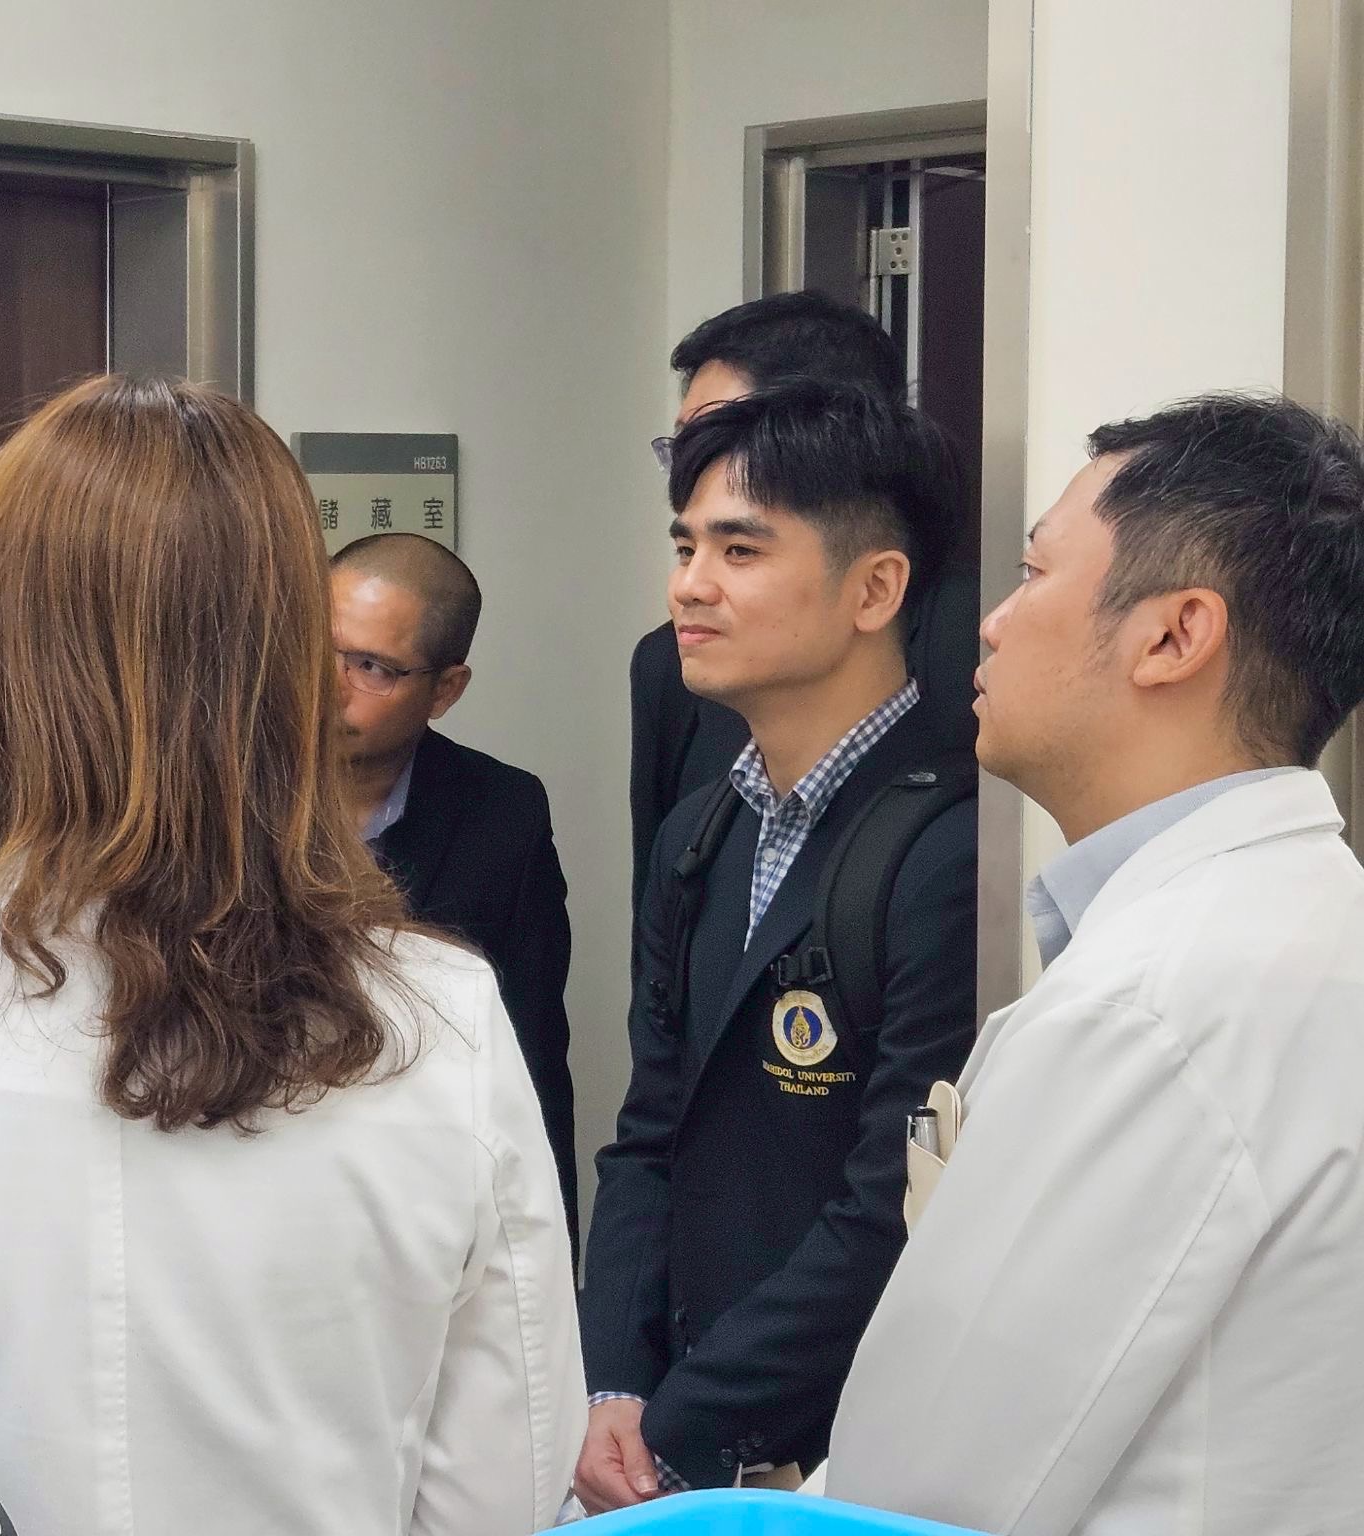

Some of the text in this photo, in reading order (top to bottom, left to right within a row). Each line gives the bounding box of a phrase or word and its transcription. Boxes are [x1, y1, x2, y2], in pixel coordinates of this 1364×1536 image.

[413, 456, 447, 470] HB1263
[797, 1070, 856, 1082] UNIVERSITY
[778, 1080, 829, 1096] THAILAND
